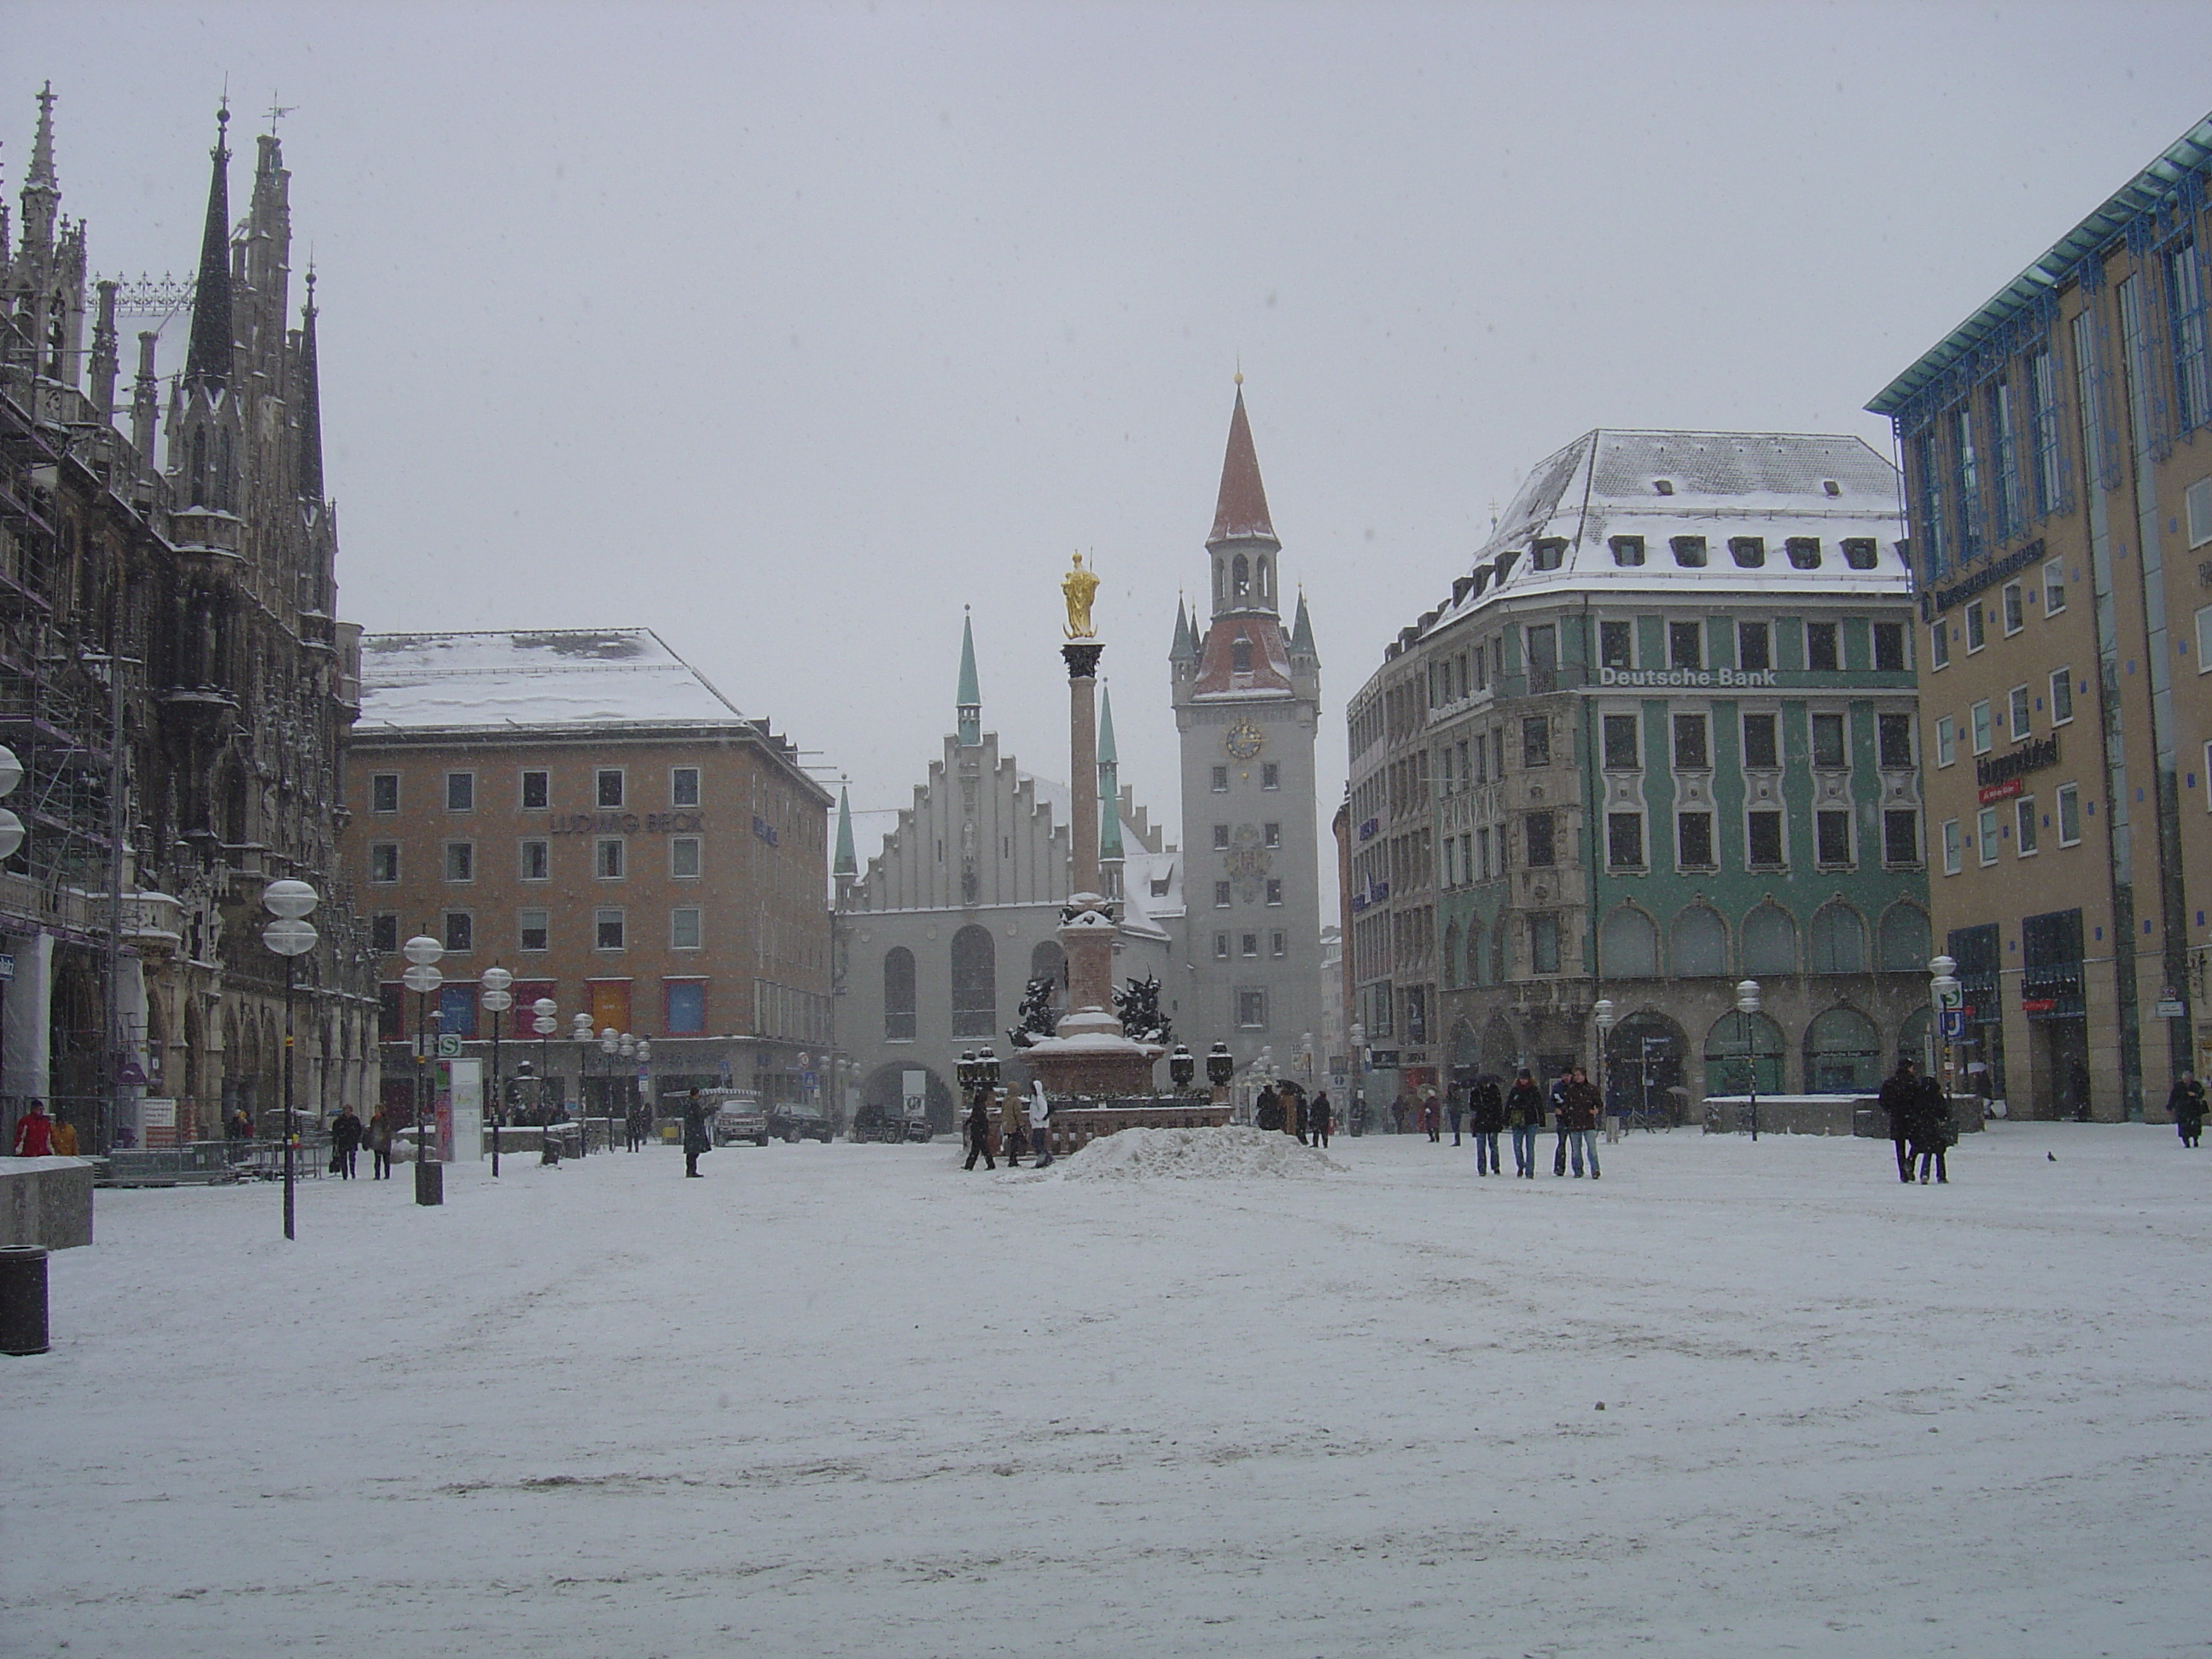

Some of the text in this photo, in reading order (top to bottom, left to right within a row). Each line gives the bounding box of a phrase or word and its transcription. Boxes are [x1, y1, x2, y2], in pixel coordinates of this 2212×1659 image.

[1599, 667, 1777, 685] Deutsche Bank
[550, 812, 705, 835] LUDWIG BECK
[441, 1038, 458, 1054] S
